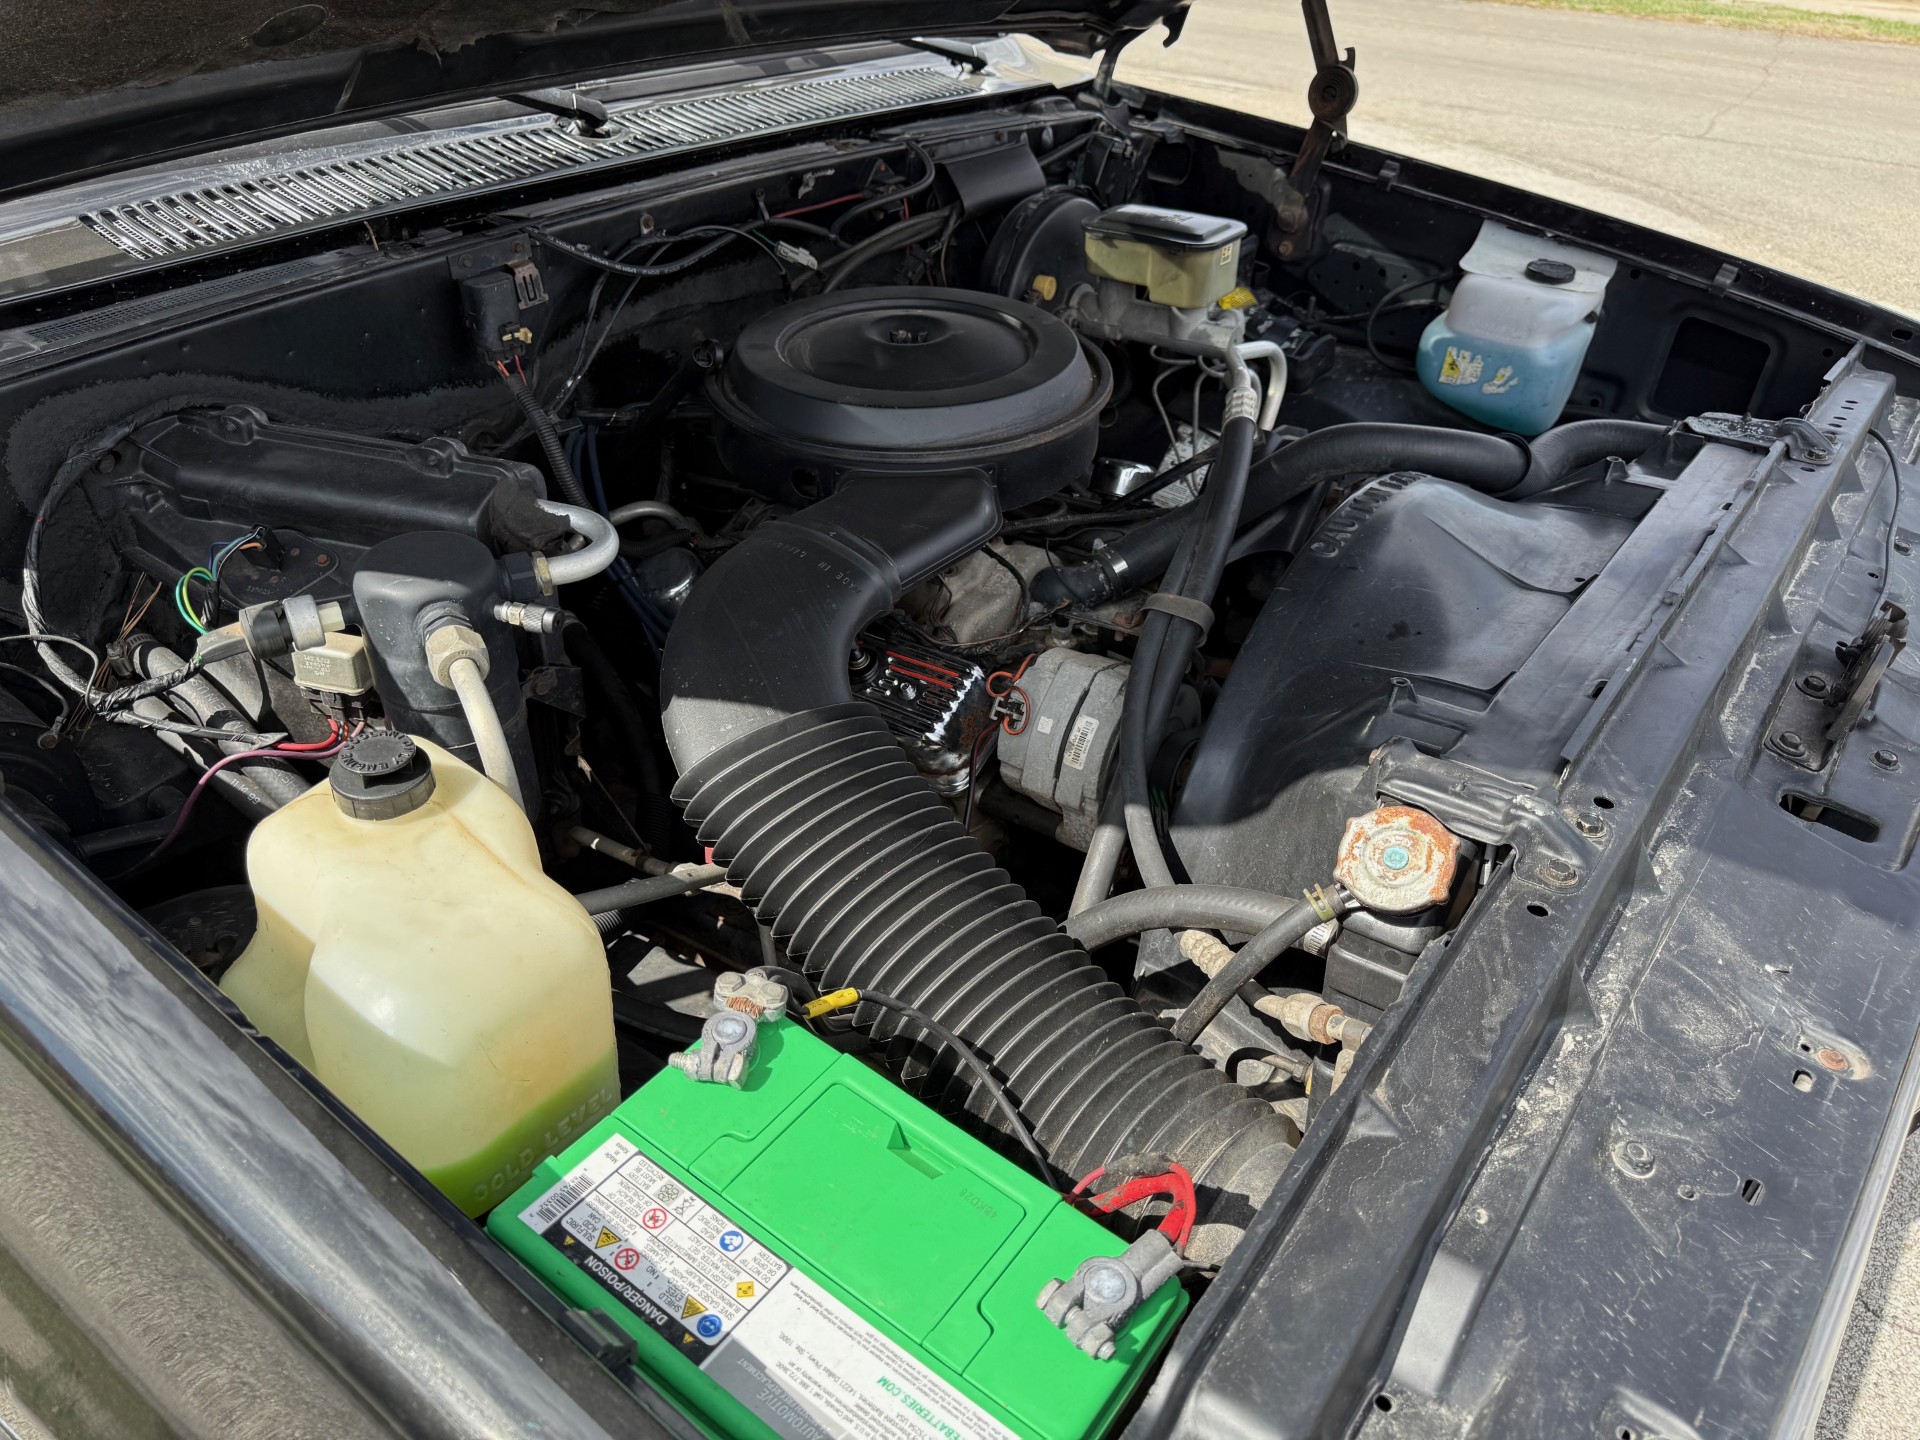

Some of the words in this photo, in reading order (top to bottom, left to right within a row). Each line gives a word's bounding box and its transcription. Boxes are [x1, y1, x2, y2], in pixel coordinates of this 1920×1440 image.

[475, 1146, 535, 1200] COLD
[542, 1086, 613, 1148] LEVEL
[633, 1165, 642, 1173] BE
[627, 1170, 650, 1190] BATTERY
[640, 1170, 656, 1184] MUST
[606, 1191, 615, 1199] OF
[614, 1197, 626, 1207] OUT
[616, 1188, 635, 1204] REACH
[624, 1205, 640, 1218] KEEP
[633, 1201, 645, 1212] THE
[588, 1212, 600, 1223] CAN
[609, 1208, 628, 1223] SEVERE
[565, 1217, 595, 1241] SULFURIC
[582, 1219, 598, 1233] ACID
[626, 1221, 636, 1230] OR
[700, 1226, 715, 1240] READ
[644, 1243, 665, 1261] FLAMES
[646, 1236, 671, 1256] SMOKING
[662, 1234, 697, 1263] IMMEDIATELY
[688, 1244, 700, 1254] GET
[701, 1243, 717, 1257] HELP
[696, 1261, 711, 1274] EYES
[716, 1255, 741, 1276] MEDICAL
[739, 1257, 749, 1266] TIP
[751, 1255, 768, 1270] OPEN
[645, 1265, 657, 1275] NO
[670, 1267, 688, 1282] CAUSE
[719, 1268, 734, 1282] WITH
[748, 1264, 762, 1275] NOT
[766, 1267, 776, 1276] OR
[710, 1272, 729, 1288] FLUSH
[760, 1273, 771, 1283] DO
[584, 1254, 668, 1325] DANGER/POISON
[664, 1285, 683, 1301] EYES.
[686, 1280, 699, 1292] CAN
[702, 1282, 711, 1290] OR
[657, 1292, 681, 1312] SHIELD
[698, 1289, 720, 1308] GASES
[710, 1287, 740, 1313] BLINDNESS
[718, 1306, 734, 1320] SIVE
[736, 1356, 782, 1394] REPLACEMENT
[778, 1391, 797, 1407] FREE
[754, 1386, 823, 1440] AUTOMOTIVE
[876, 1375, 961, 1440] EBATTERIES.COM
[894, 1412, 908, 1424] USA
[907, 1422, 927, 1438] 75254
